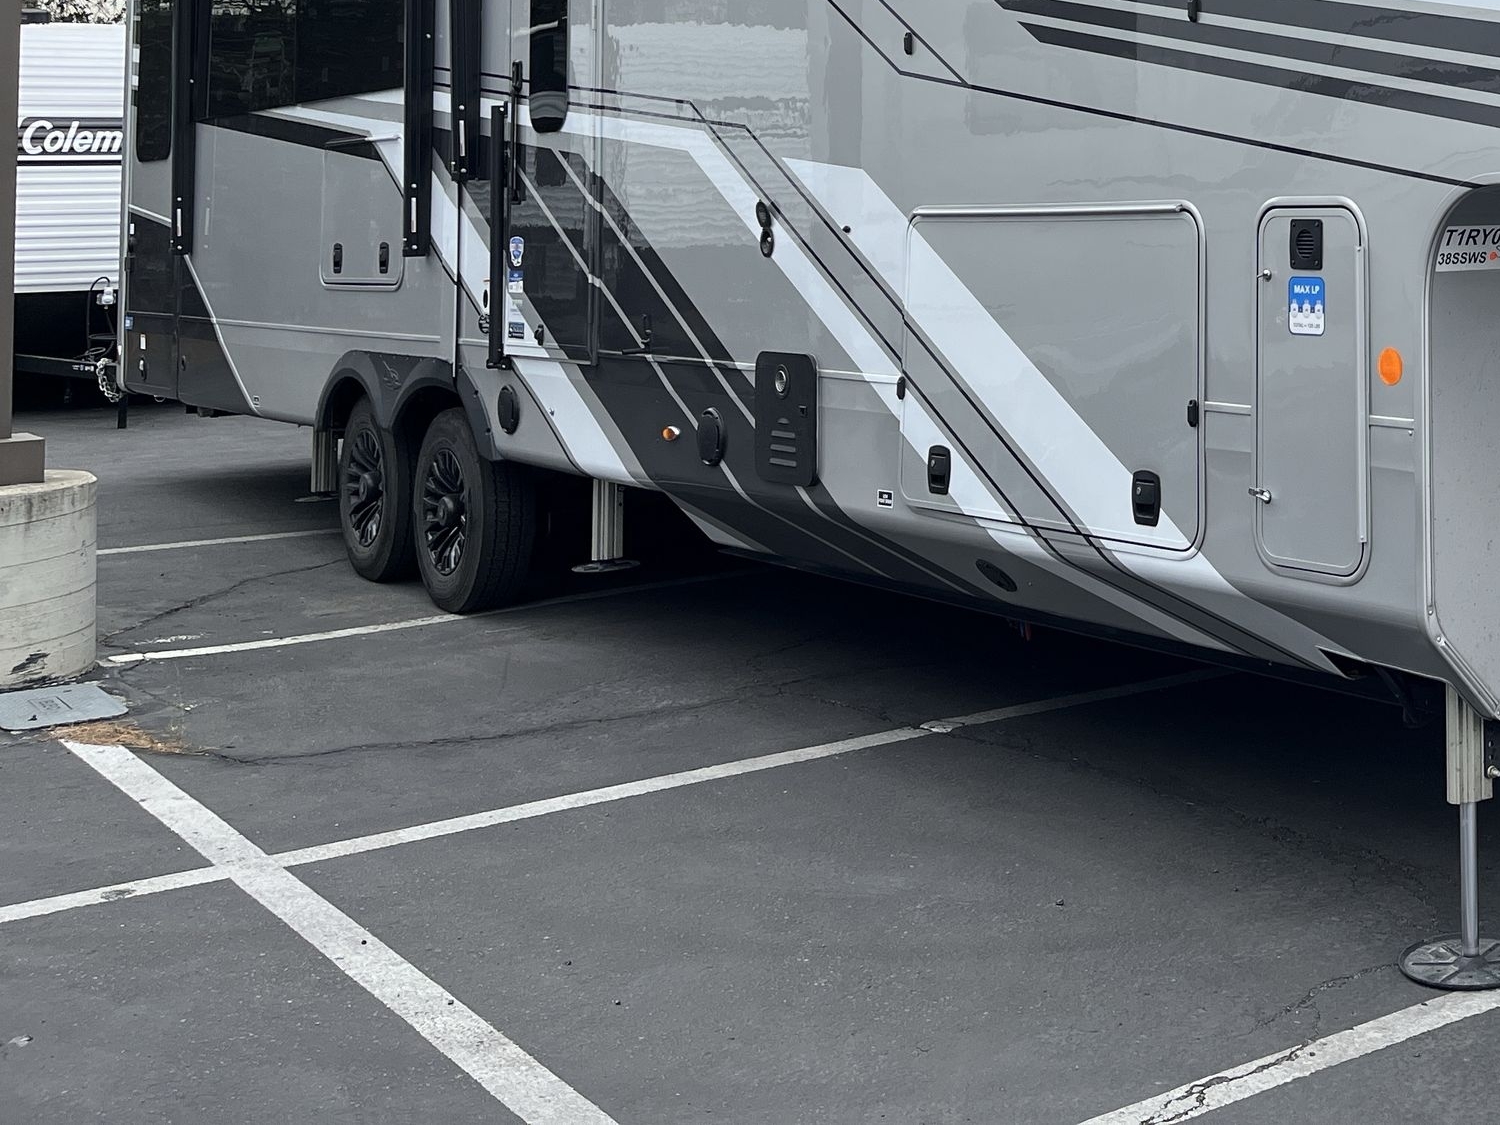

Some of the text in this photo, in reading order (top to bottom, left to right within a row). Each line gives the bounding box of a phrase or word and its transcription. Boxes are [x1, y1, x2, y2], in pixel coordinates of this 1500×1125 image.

[22, 119, 123, 155] Colem
[1438, 251, 1487, 265] 38SSWS
[1293, 284, 1320, 294] MAX LP
